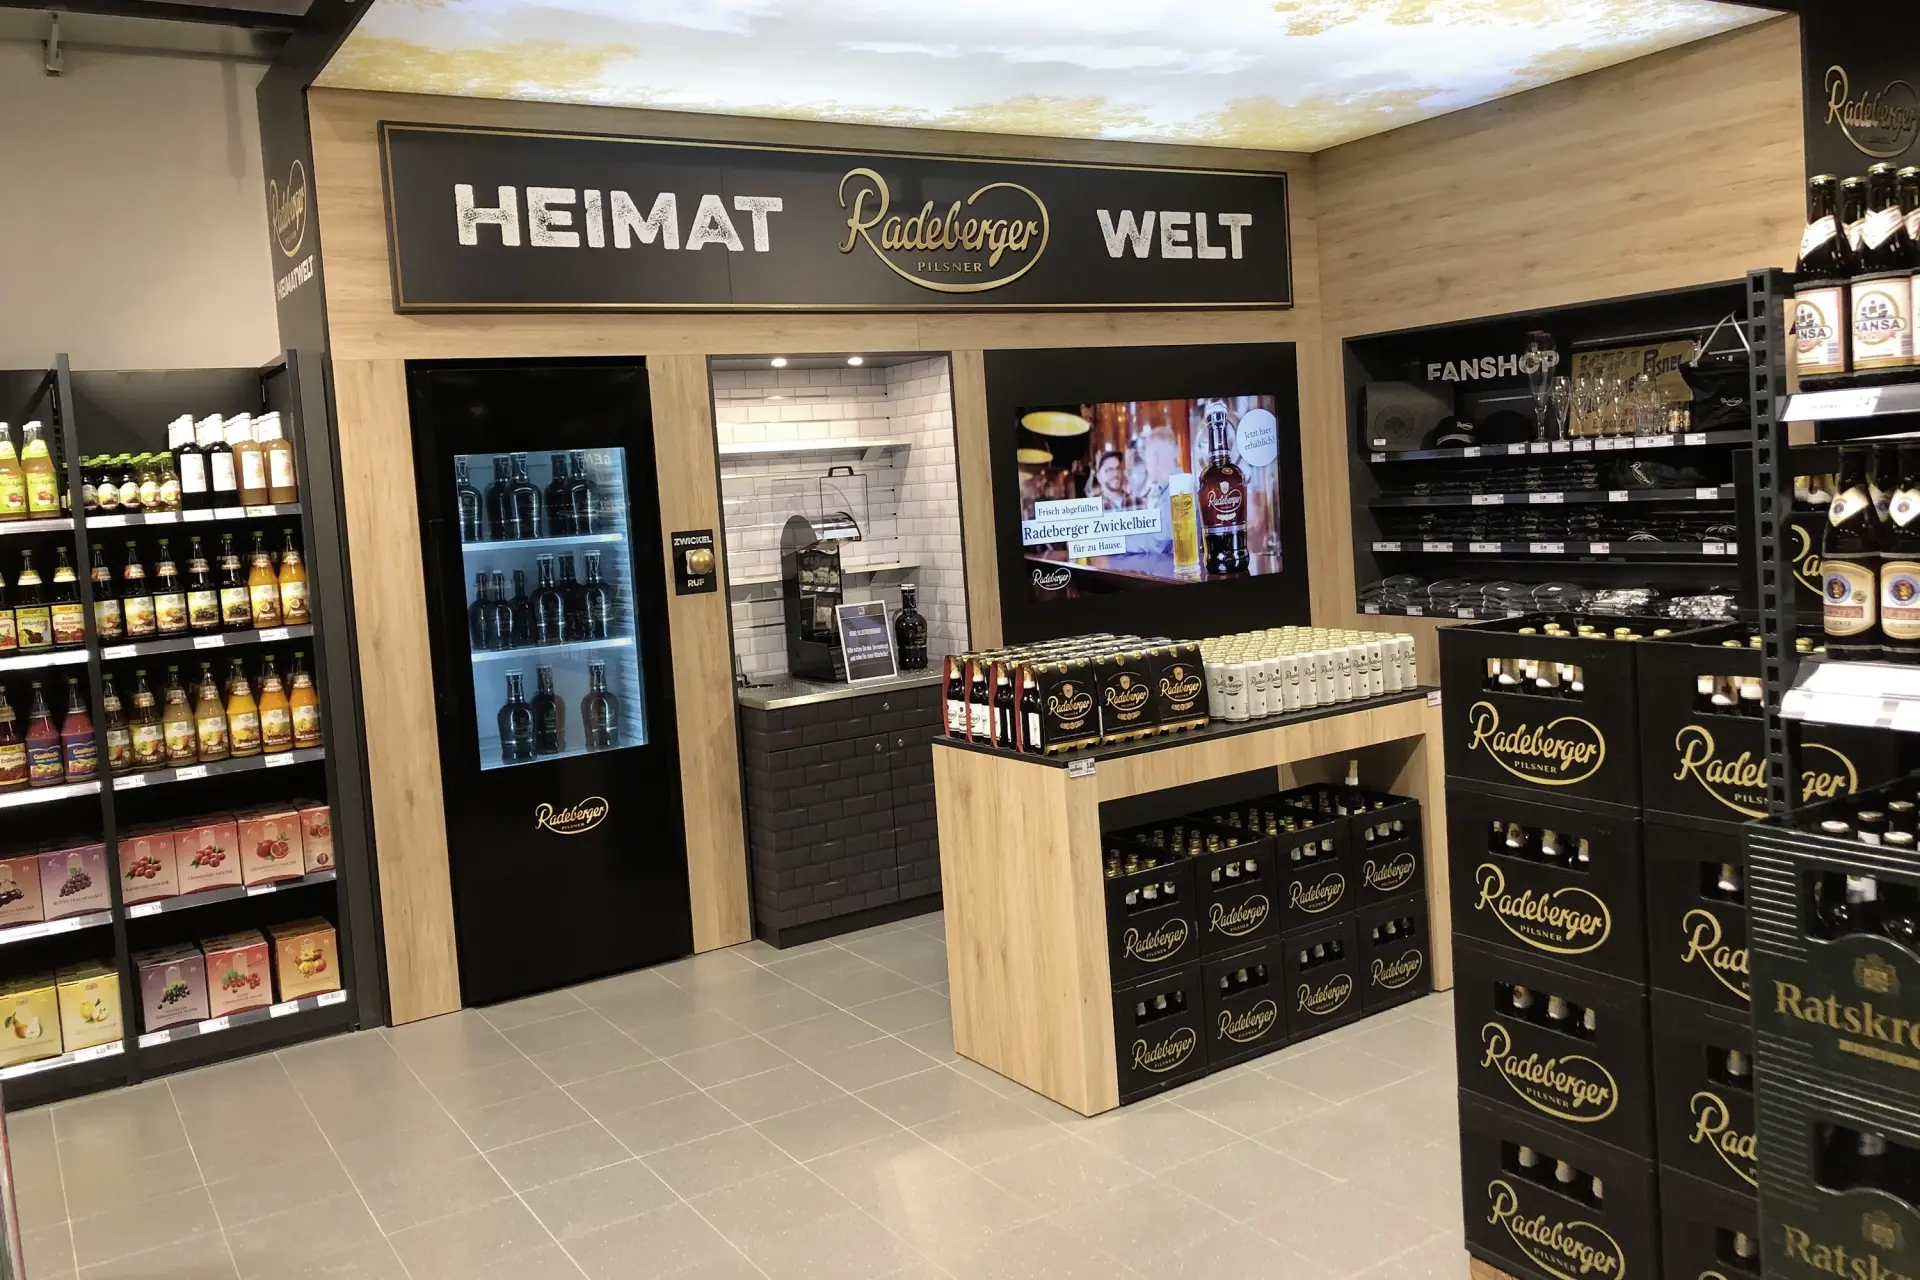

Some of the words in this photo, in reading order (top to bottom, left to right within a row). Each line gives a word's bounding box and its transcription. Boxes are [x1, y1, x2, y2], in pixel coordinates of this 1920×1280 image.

[454, 183, 784, 252] HEIMAT
[838, 167, 1046, 281] Radeberger
[1096, 209, 1253, 260] WELT
[276, 254, 314, 302] HEIMATWELT
[917, 261, 983, 273] PILSNER
[1427, 350, 1560, 382] FANSHOP
[1259, 427, 1272, 437] hier
[1038, 506, 1061, 516] Frisch
[1061, 503, 1099, 516] abgefülltes
[673, 535, 713, 546] ZWICKEL
[1023, 524, 1090, 541] Radeberger
[1093, 516, 1157, 534] Zwickelbier
[1073, 545, 1085, 554] für
[1098, 541, 1123, 551] Hause.
[687, 578, 705, 587] RUF
[1032, 569, 1071, 588] Radeberger
[1048, 694, 1093, 719] Radeberger
[1104, 685, 1149, 710] Radeberger
[1159, 677, 1202, 701] Radeberger
[1468, 701, 1604, 780] Radeberger
[1513, 760, 1557, 774] PILSNER
[535, 797, 608, 833] Radeberger
[1363, 854, 1415, 890] Radeberger
[1288, 874, 1345, 912] Radeberger
[1474, 863, 1610, 949] Radeberger
[1208, 896, 1269, 935] Radeberger
[1520, 924, 1563, 942] PILSNER
[1123, 920, 1188, 962] Radeberger
[1371, 950, 1423, 988] Radeberger
[1297, 974, 1352, 1014] Radeberger
[1218, 1001, 1277, 1041] Radeberger
[1131, 1029, 1196, 1072] Radeberger
[1480, 1022, 1617, 1118] Radeberger
[1526, 1087, 1570, 1109] PILSNER
[1487, 1179, 1624, 1279] Radeberger
